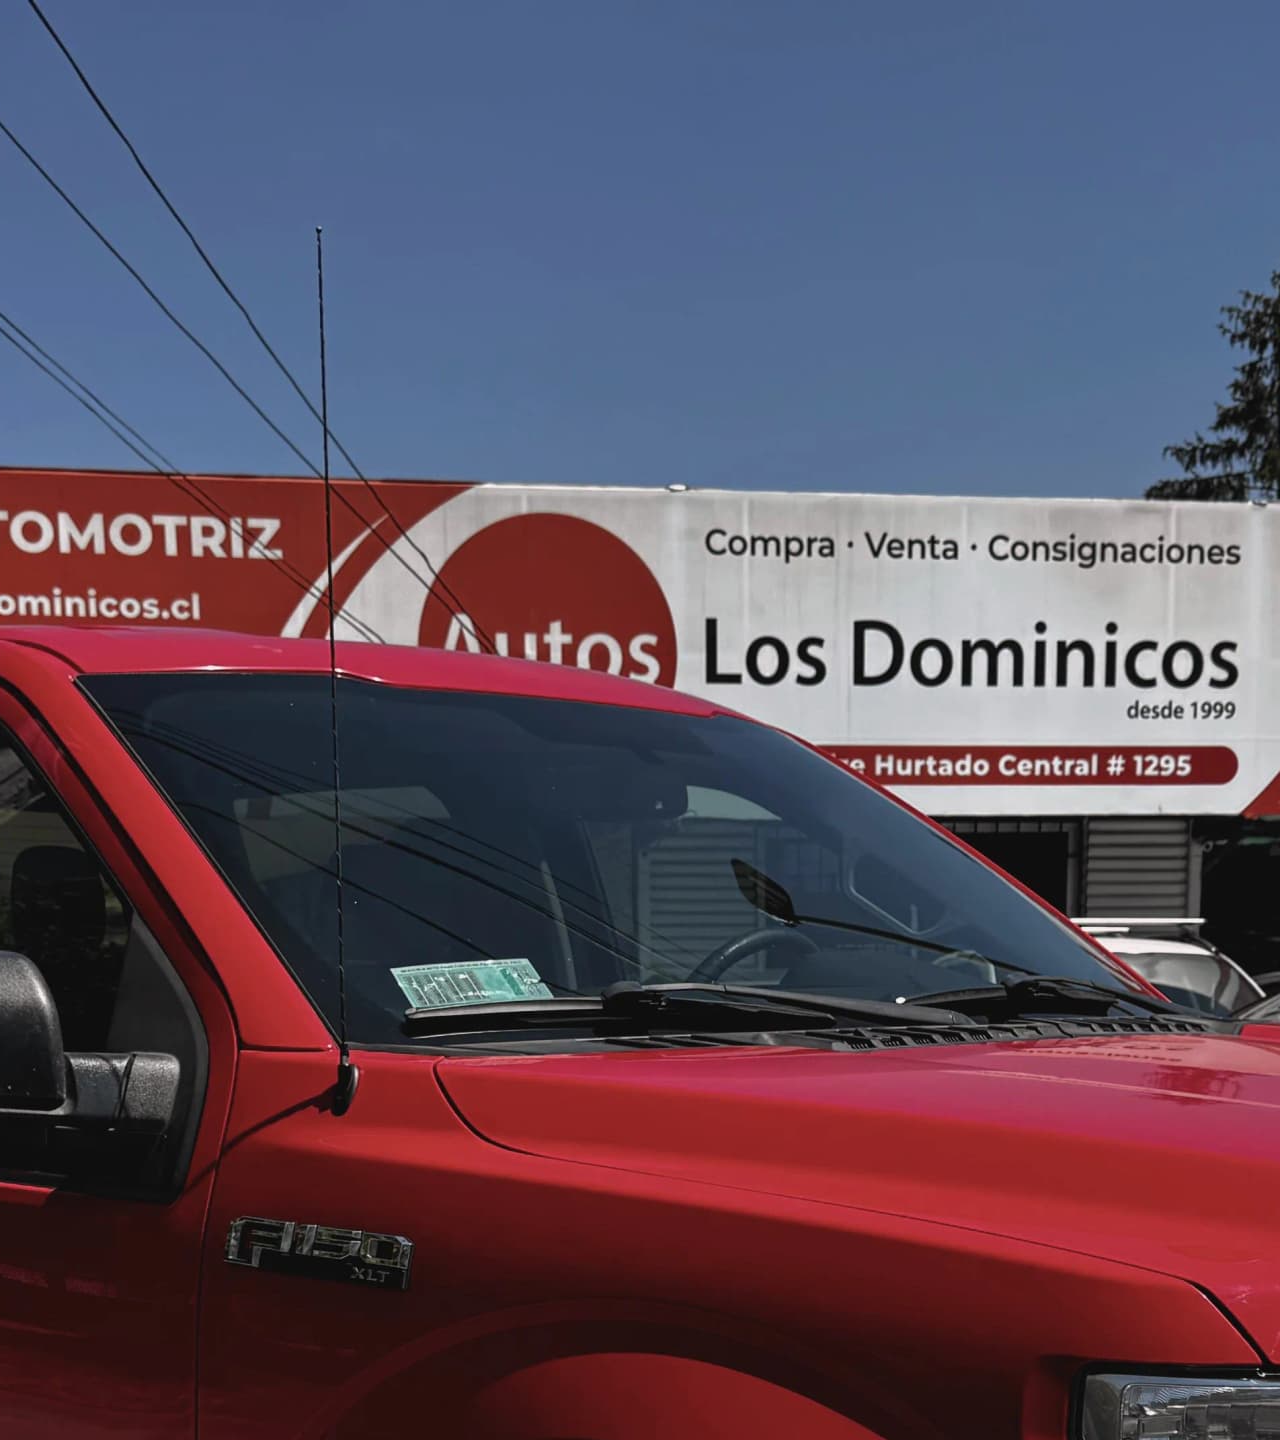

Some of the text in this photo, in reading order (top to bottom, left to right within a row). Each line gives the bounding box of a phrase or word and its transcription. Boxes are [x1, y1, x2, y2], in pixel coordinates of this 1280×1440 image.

[704, 529, 1241, 568] Compra Venta Consignaciones
[444, 612, 661, 685] Autos
[704, 617, 1239, 690] Los Dominicos
[1127, 700, 1237, 720] desde 1999
[874, 754, 991, 777] Hurtado
[998, 754, 1099, 777] Central
[1133, 755, 1193, 777] 1295
